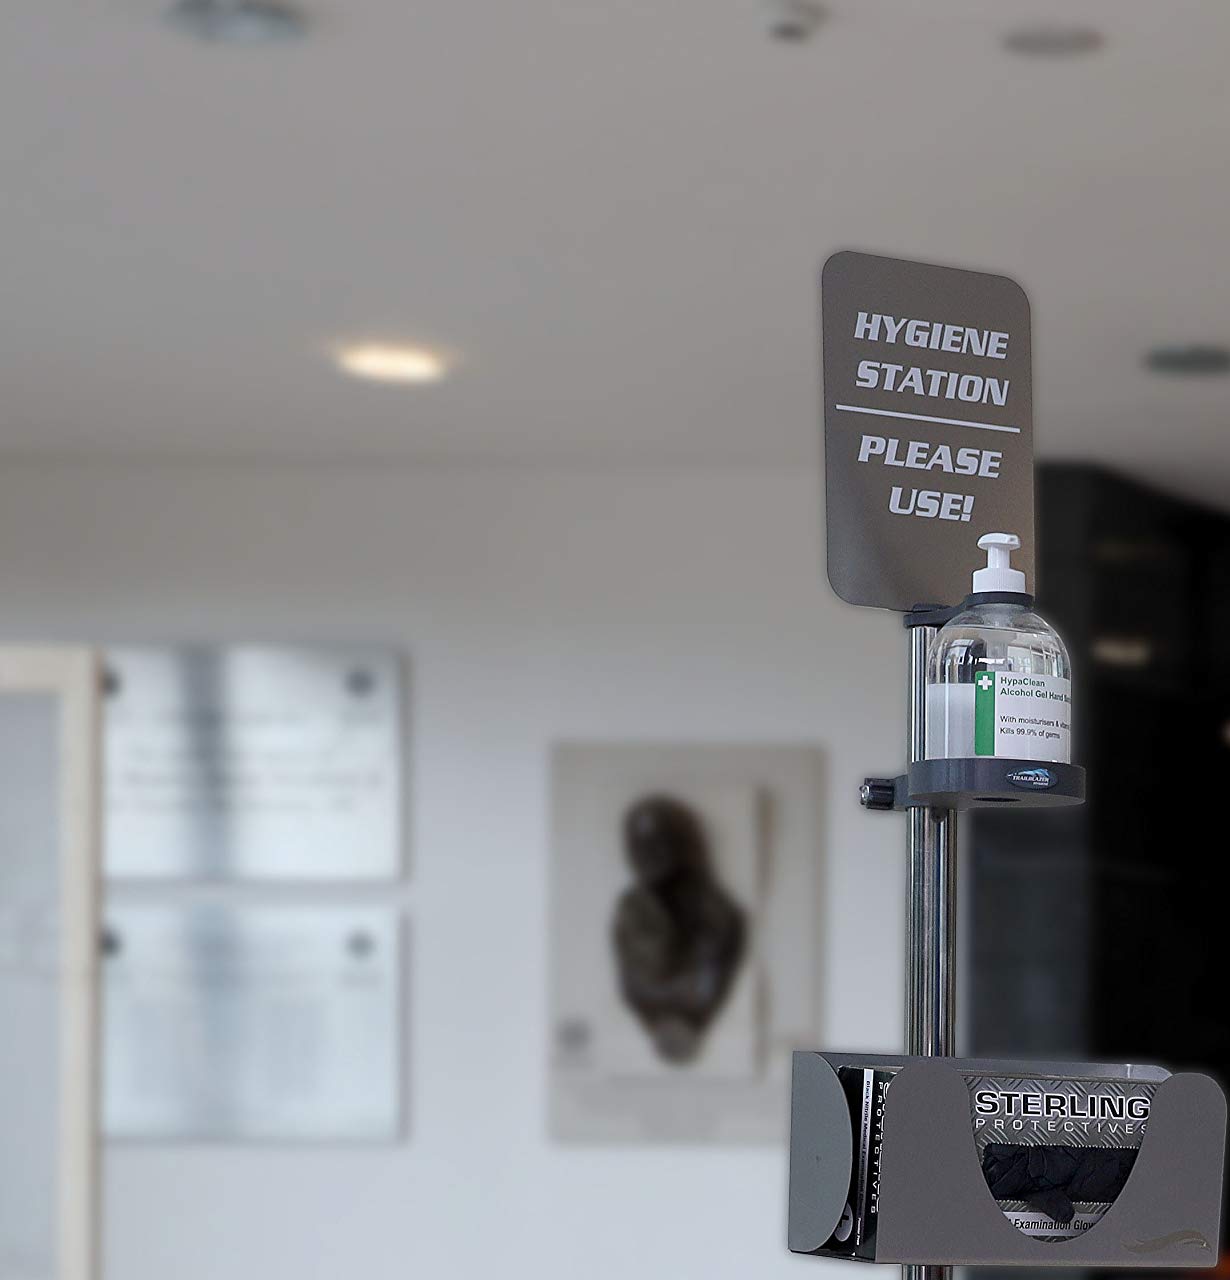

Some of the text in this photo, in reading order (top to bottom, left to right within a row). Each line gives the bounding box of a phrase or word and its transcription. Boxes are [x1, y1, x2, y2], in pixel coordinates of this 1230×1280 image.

[854, 311, 1009, 360] HYGIENE
[855, 360, 1010, 406] STATION
[857, 435, 1003, 479] PLEASE
[888, 486, 975, 522] USE!
[1000, 676, 1045, 687] HypaClean
[1000, 687, 1033, 697] Alcohol
[1035, 690, 1048, 699] Gel
[1049, 691, 1063, 701] Hand
[1000, 715, 1017, 723] With
[1000, 727, 1015, 735] Kills
[1016, 728, 1037, 736] 99.9%
[975, 1090, 1151, 1121] STERLING
[975, 1119, 1147, 1135] PROTECTIVES
[870, 1081, 884, 1214] PROTECTIVES
[1014, 1219, 1097, 1231] Examination Glov
